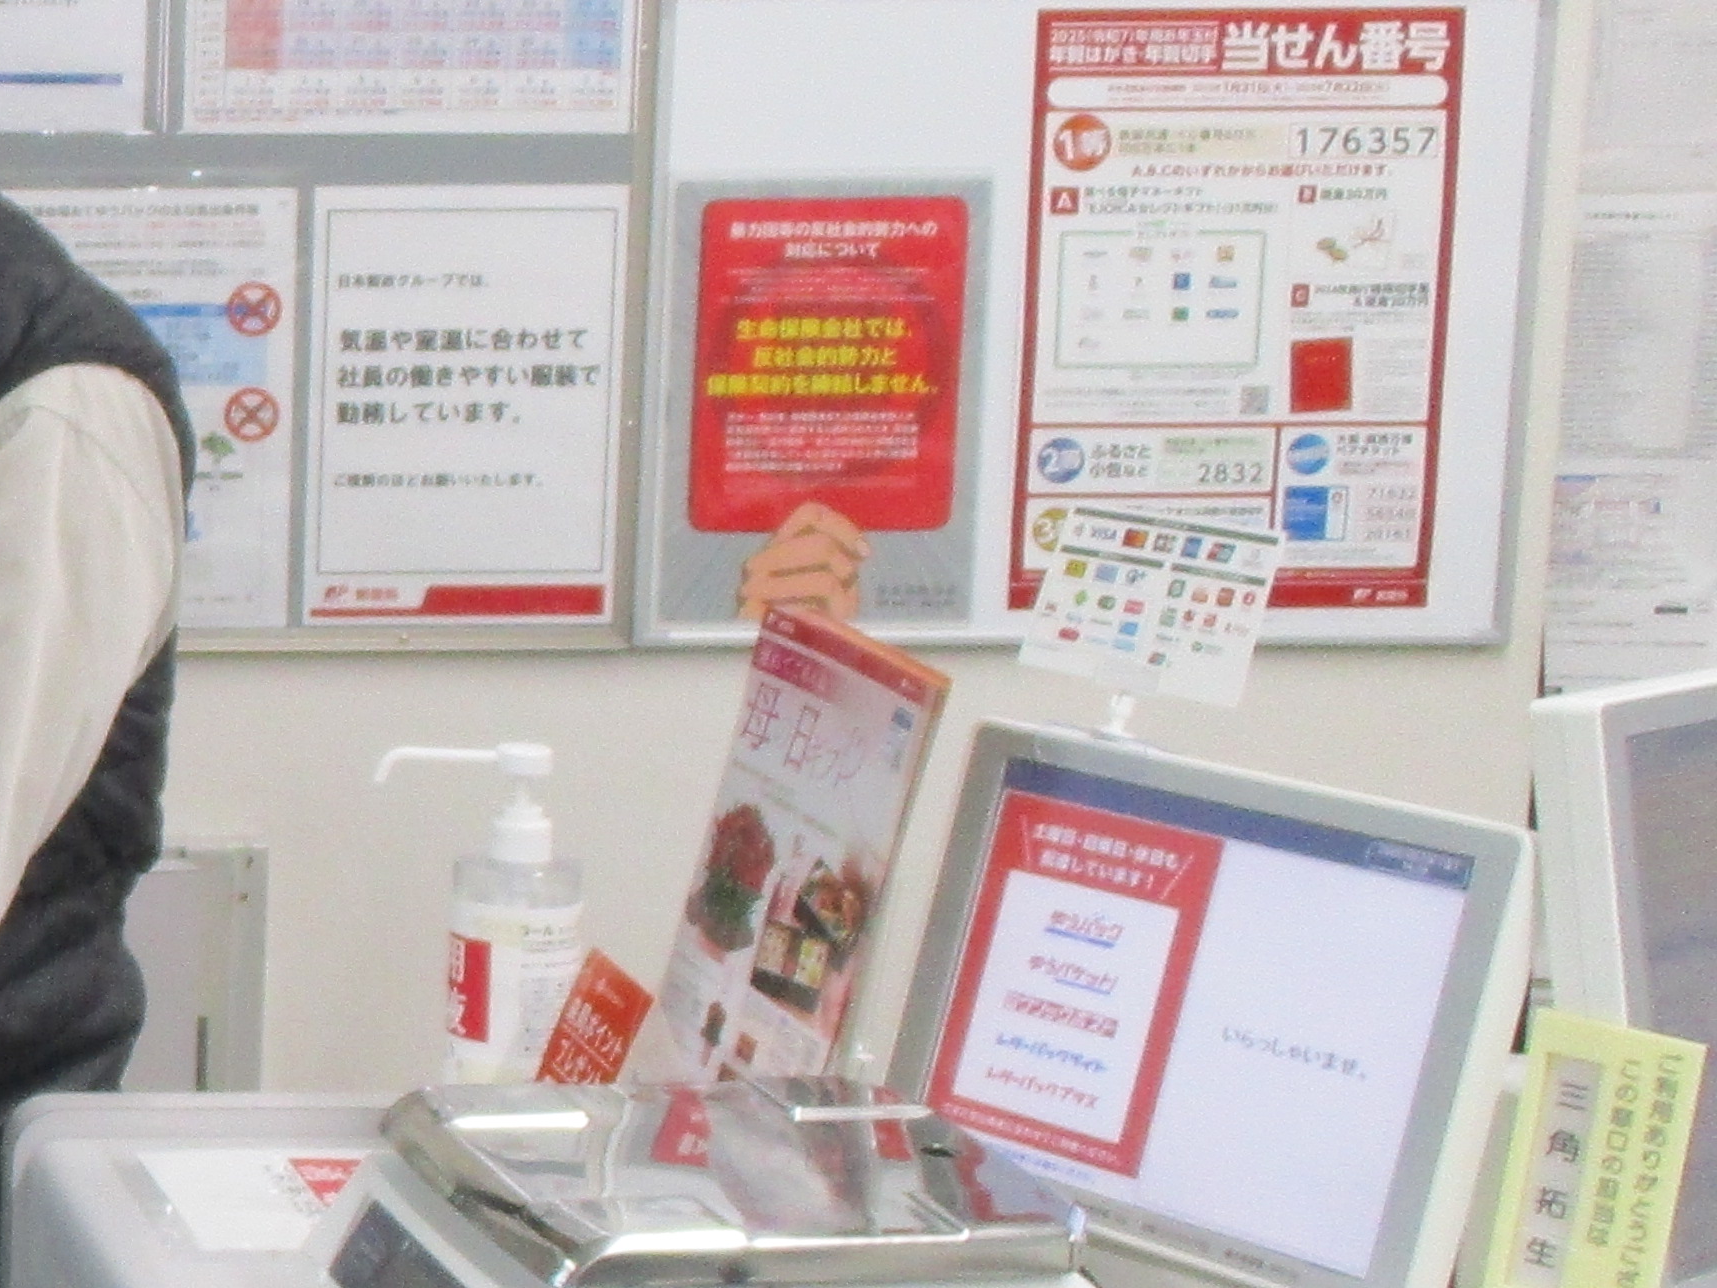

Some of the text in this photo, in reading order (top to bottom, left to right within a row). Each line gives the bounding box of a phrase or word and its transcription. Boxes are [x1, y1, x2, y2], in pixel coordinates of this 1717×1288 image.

[1222, 20, 1451, 71] 当せん番号
[1296, 125, 1438, 156] 176357
[340, 328, 588, 352] 気温や室温に合わせて
[337, 365, 600, 388] 社員の働きやすい服装で
[337, 401, 521, 425] 勤務しています。
[1090, 443, 1152, 460] ふるさと
[1198, 463, 1264, 485] 2832
[1222, 1027, 1366, 1079] いらっしゃいませ。
